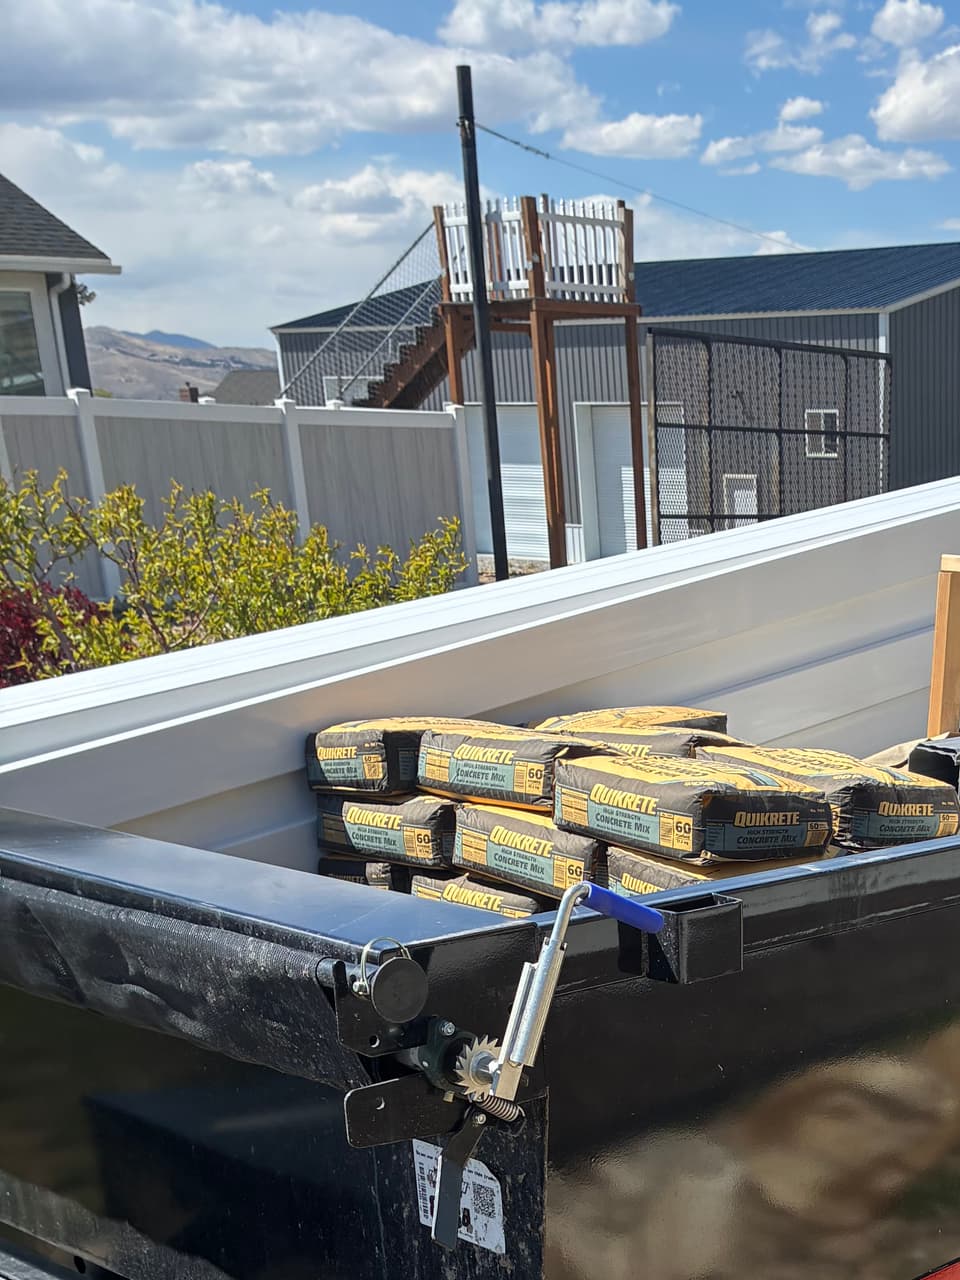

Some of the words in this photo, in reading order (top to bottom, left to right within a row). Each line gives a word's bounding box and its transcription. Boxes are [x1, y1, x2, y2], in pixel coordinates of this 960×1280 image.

[318, 747, 357, 760] QUIKRETE
[454, 744, 517, 765] QUIKRETE
[456, 767, 490, 781] CONCRETE
[491, 772, 506, 782] MIX
[528, 768, 543, 779] 60
[590, 783, 659, 815] QUIKRETE
[878, 801, 934, 816] QUIKRETE
[346, 806, 403, 829] QUIKRETE
[595, 812, 632, 829] CONCRETE
[634, 820, 650, 834] MIX
[734, 811, 800, 827] QUIKRETE
[675, 821, 692, 834] 60
[351, 831, 381, 844] CONCRETE
[416, 834, 430, 844] 60
[489, 825, 555, 858] QUIKRETE
[493, 852, 528, 871] CONCRETE
[530, 862, 545, 875] MIX
[567, 864, 582, 877] 60
[442, 883, 505, 911] QUIKRETE
